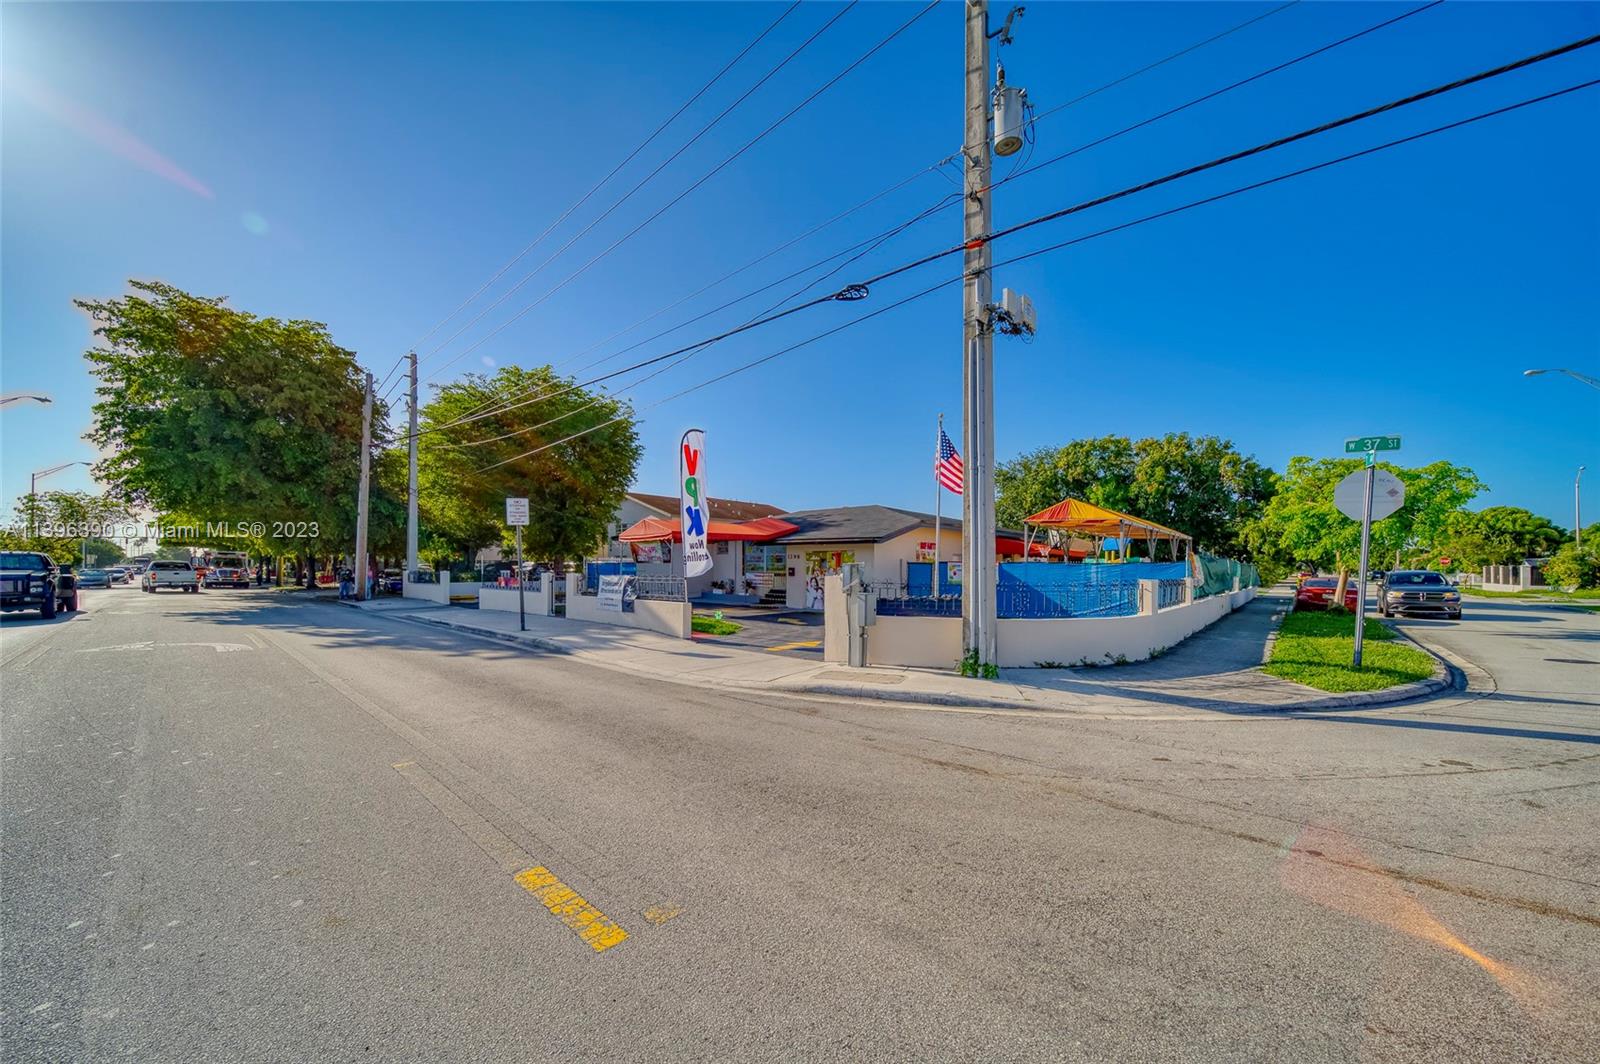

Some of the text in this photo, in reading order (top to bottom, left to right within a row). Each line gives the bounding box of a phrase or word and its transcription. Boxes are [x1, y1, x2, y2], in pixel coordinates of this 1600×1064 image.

[1348, 439, 1397, 451] W 37 ST
